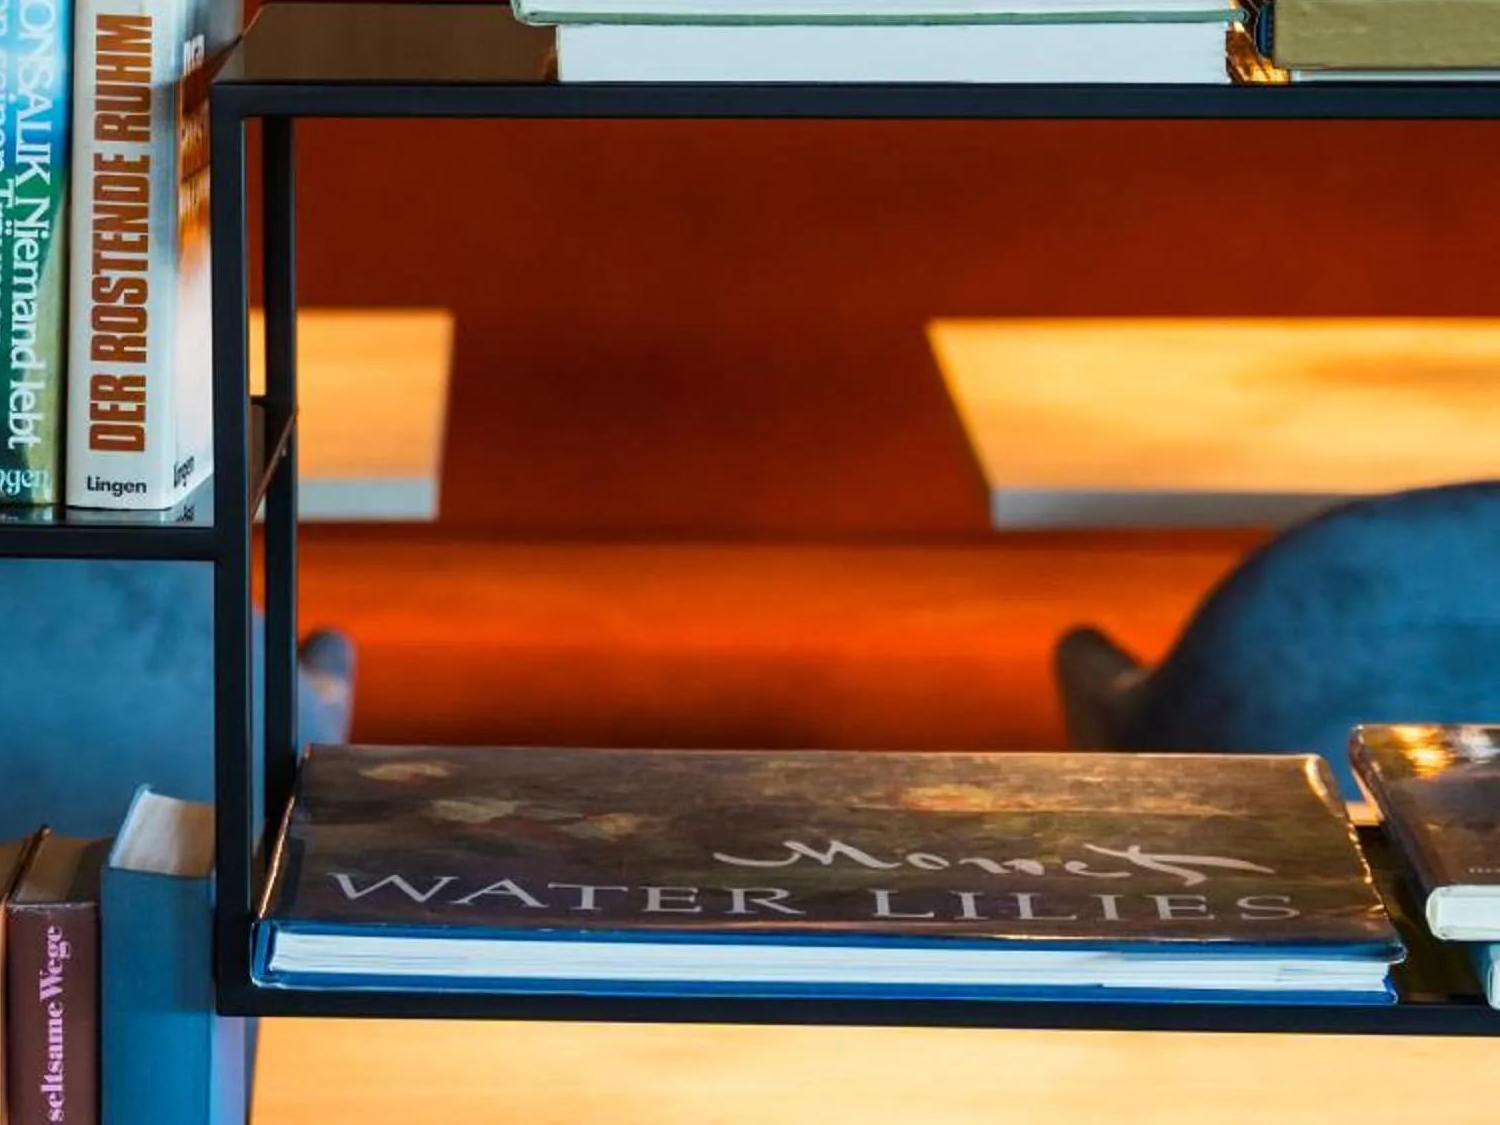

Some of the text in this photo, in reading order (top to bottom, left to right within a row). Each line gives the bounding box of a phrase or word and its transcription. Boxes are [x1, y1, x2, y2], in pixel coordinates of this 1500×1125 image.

[88, 13, 153, 453] DER ROSTENDE RUHM
[10, 197, 50, 371] Niemand
[8, 380, 46, 450] lebt
[86, 474, 148, 498] Lingen
[331, 872, 1302, 921] WATER LILIES
